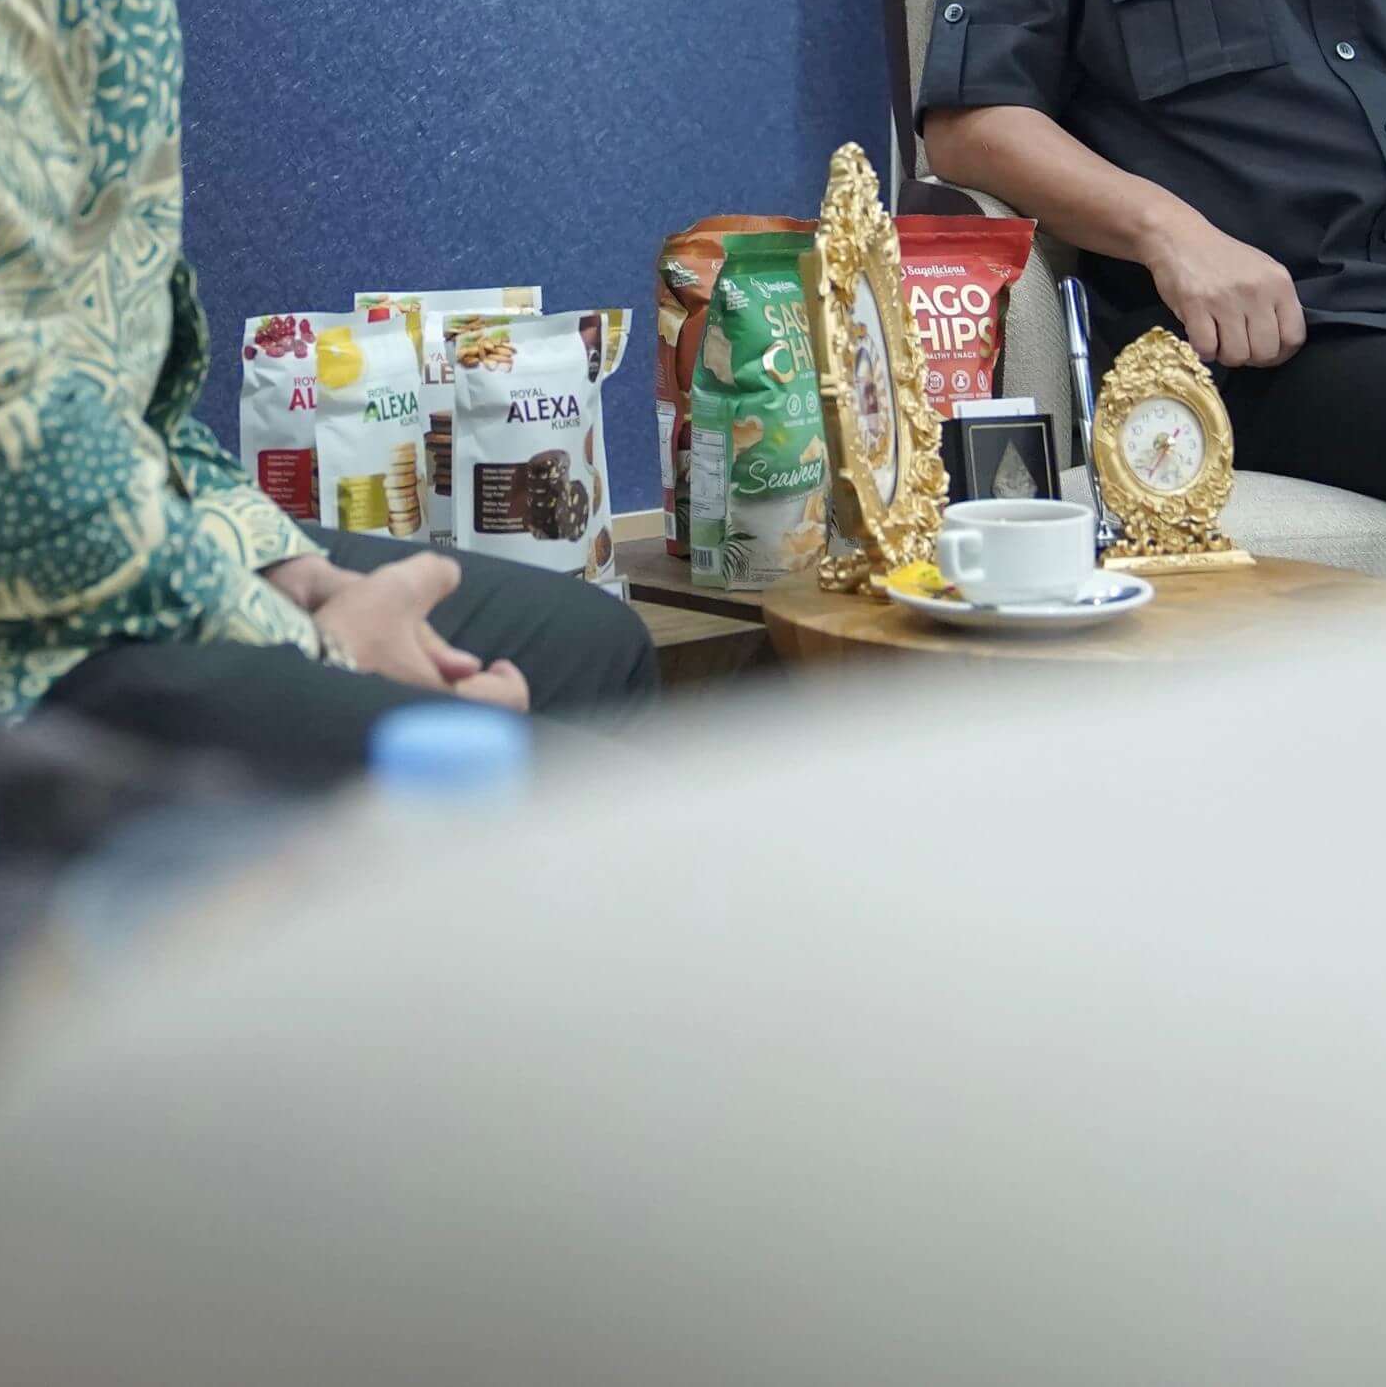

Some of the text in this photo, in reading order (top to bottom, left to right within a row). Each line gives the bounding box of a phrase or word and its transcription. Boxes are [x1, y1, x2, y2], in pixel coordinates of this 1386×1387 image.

[910, 284, 991, 316] AGO
[914, 317, 994, 358] HIPS
[294, 376, 317, 387] ROY
[510, 387, 546, 400] ROYAL
[363, 391, 418, 422] ALEXA
[507, 395, 580, 423] ALEXA
[738, 457, 822, 494] Seaweed
